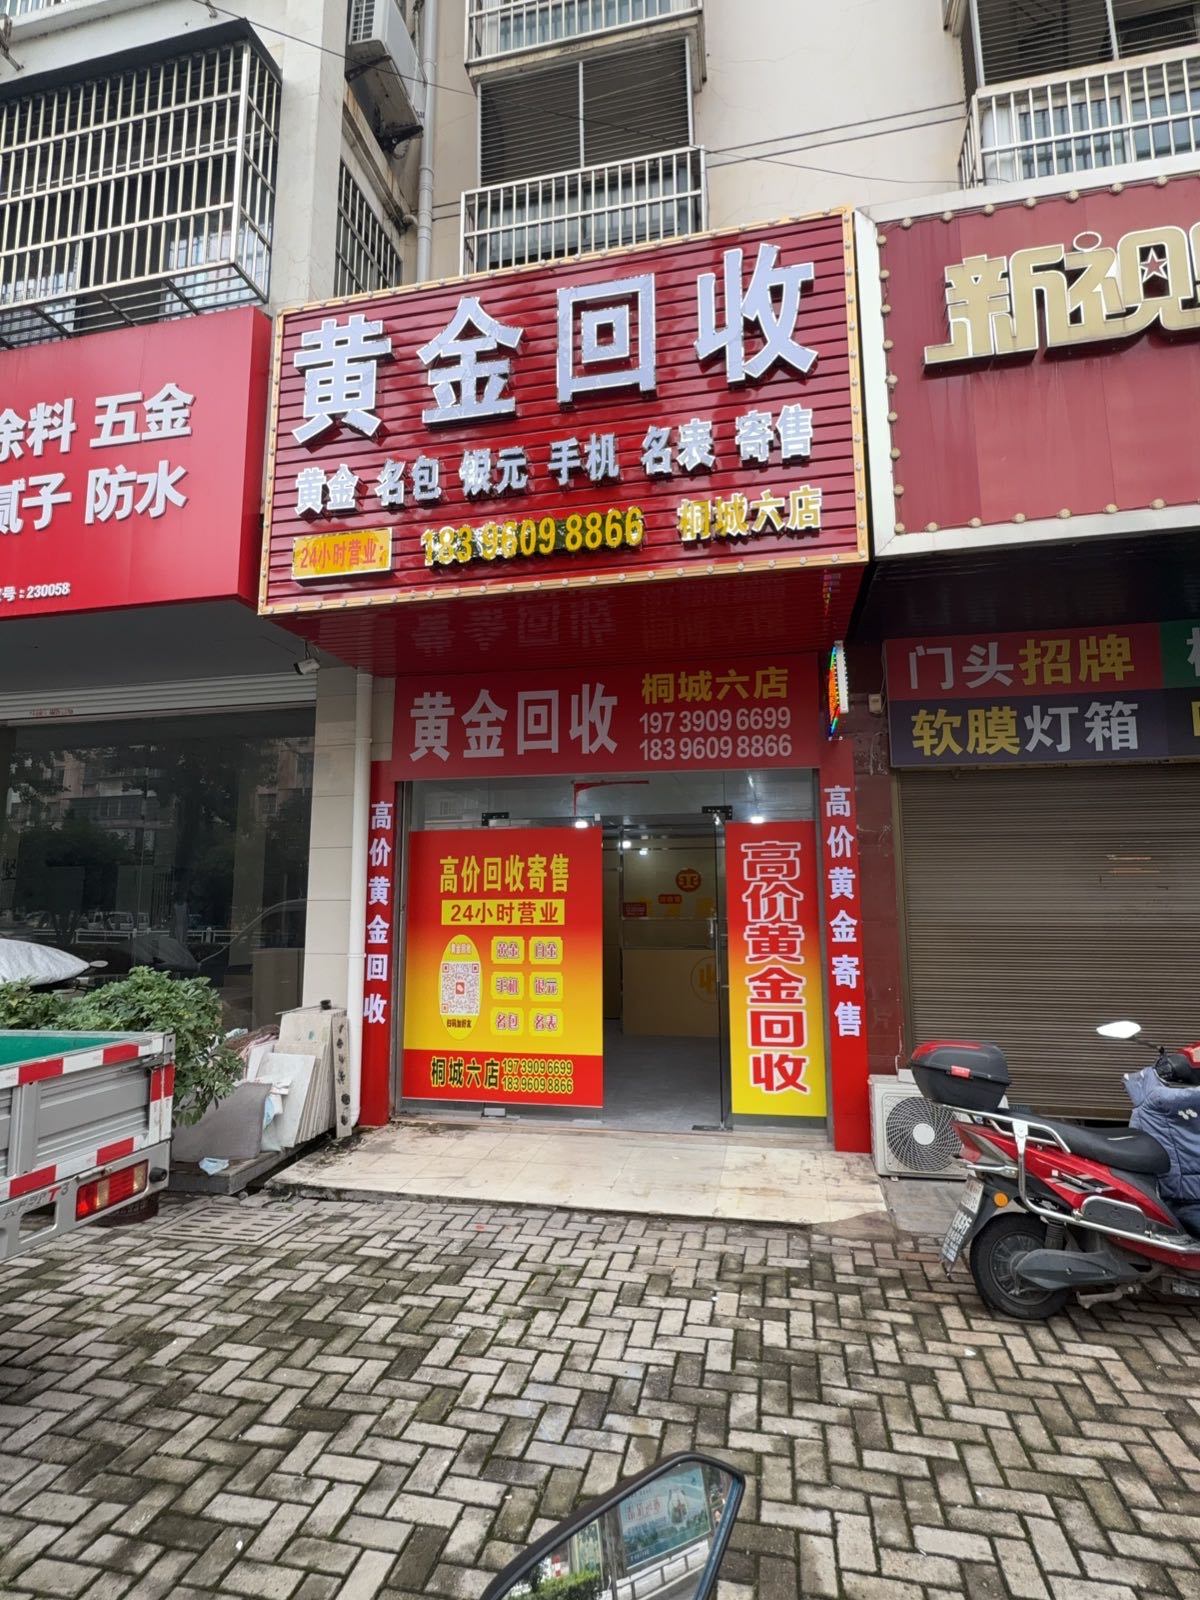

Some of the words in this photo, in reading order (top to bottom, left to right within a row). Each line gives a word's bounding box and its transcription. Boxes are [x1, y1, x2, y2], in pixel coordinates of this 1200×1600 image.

[924, 221, 1200, 366] 新视
[291, 242, 819, 446] 黄金回收
[89, 382, 194, 448] 五金
[293, 463, 360, 516] 黄金
[375, 456, 441, 507] 名包
[459, 446, 529, 496] 银元
[548, 431, 620, 486] 手机
[641, 417, 716, 476] 名表
[735, 402, 814, 461] 寄售
[85, 459, 187, 524] 防水
[677, 484, 822, 542] 桐城六店
[641, 666, 789, 705] 桐城六店
[908, 633, 1135, 690] 门头招牌
[408, 682, 619, 763] 黄金回收
[911, 701, 1139, 757] 软膜灯箱
[439, 854, 570, 894] 高价回收寄售
[363, 801, 393, 1024] 高价黄金回收
[450, 901, 560, 925] 24小时营业
[823, 785, 862, 1037] 高价黄金寄售
[497, 941, 519, 959] 黄金
[535, 941, 557, 959] 白金
[740, 840, 811, 1095] 高价黄金回收
[496, 977, 519, 995] 手机
[535, 977, 557, 995] 银元
[496, 1012, 519, 1031] 名包
[535, 1012, 557, 1032] 名表
[431, 1056, 500, 1090] 桐城六店
